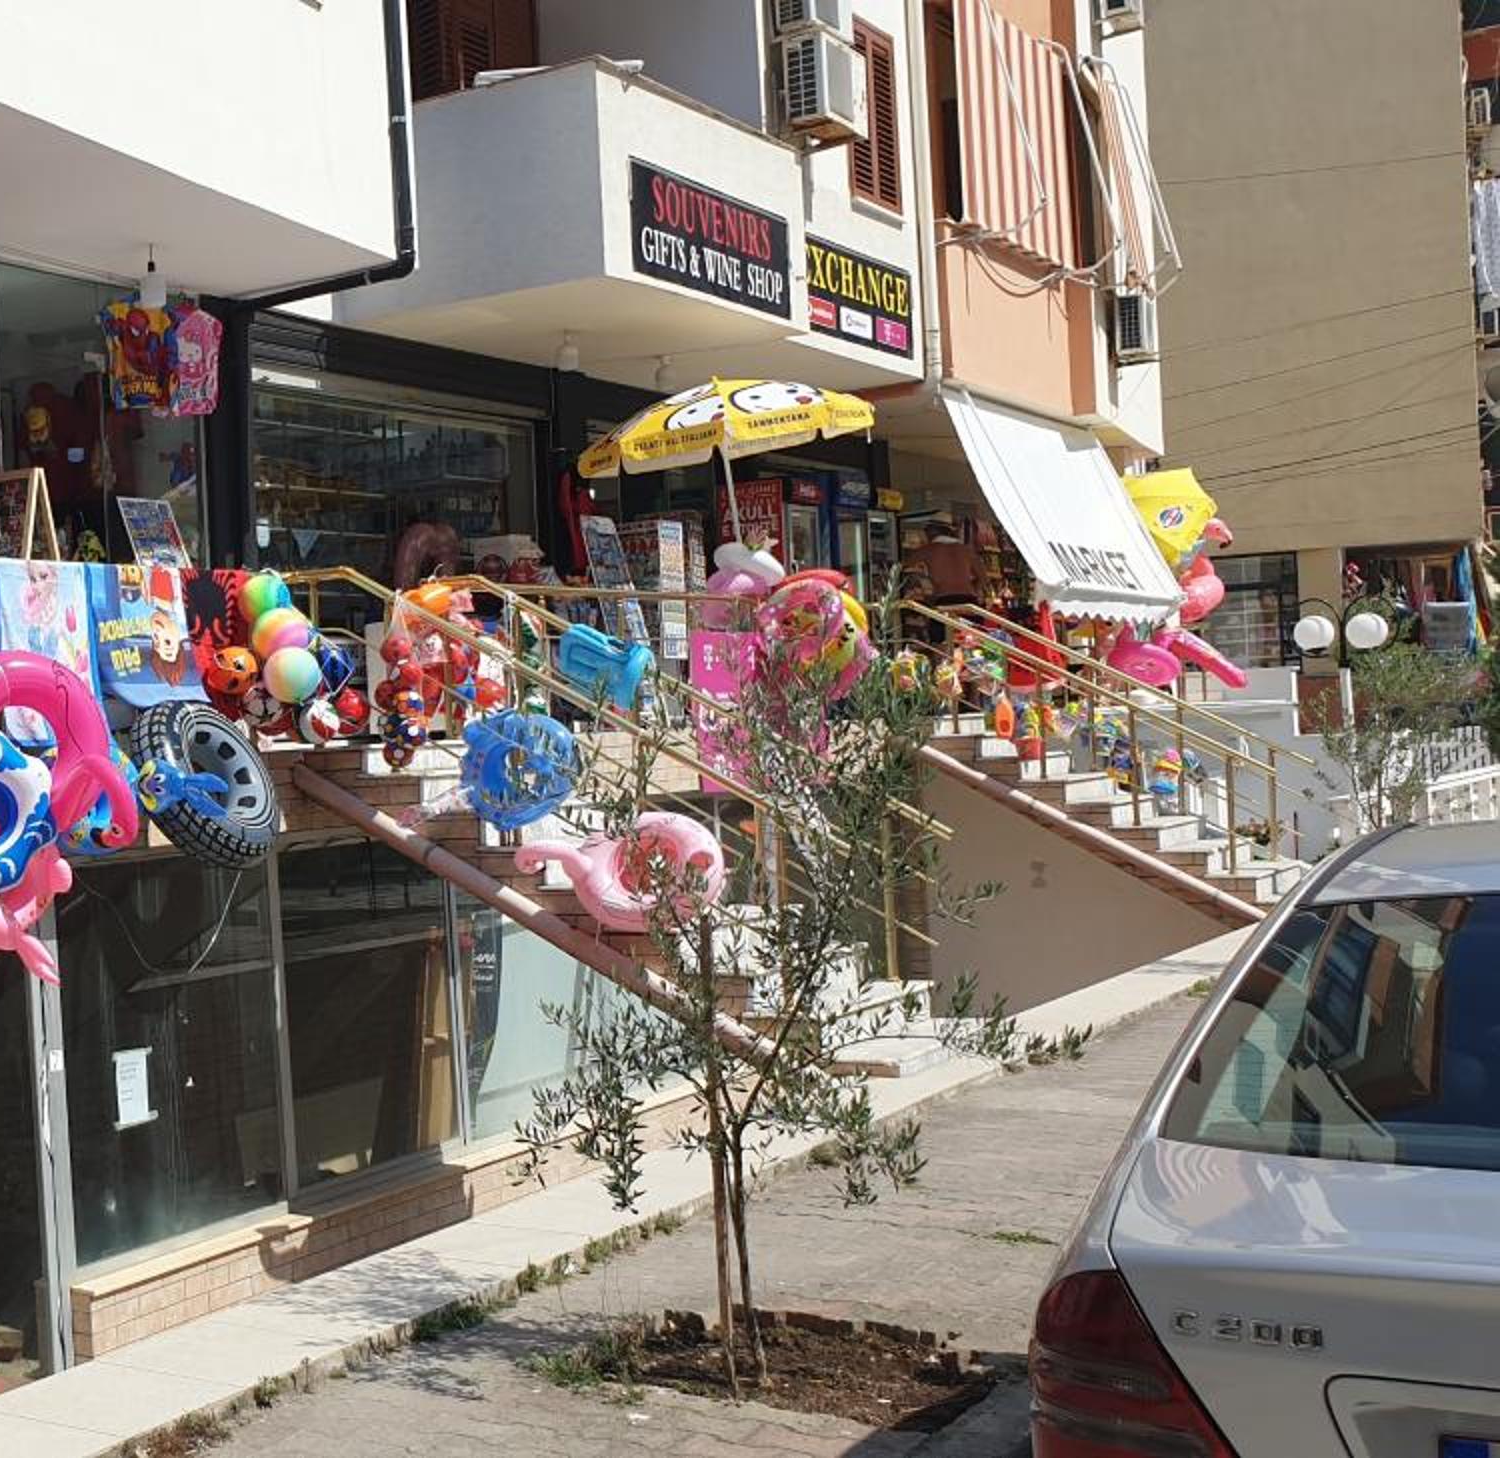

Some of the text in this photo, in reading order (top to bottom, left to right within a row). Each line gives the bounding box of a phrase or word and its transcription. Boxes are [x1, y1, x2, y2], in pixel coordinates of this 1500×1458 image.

[653, 174, 771, 262] SOUVENIRS
[641, 226, 783, 305] GIFTS & WINE SHOP
[1048, 541, 1145, 590] MARKET
[1173, 1310, 1324, 1350] C 200
